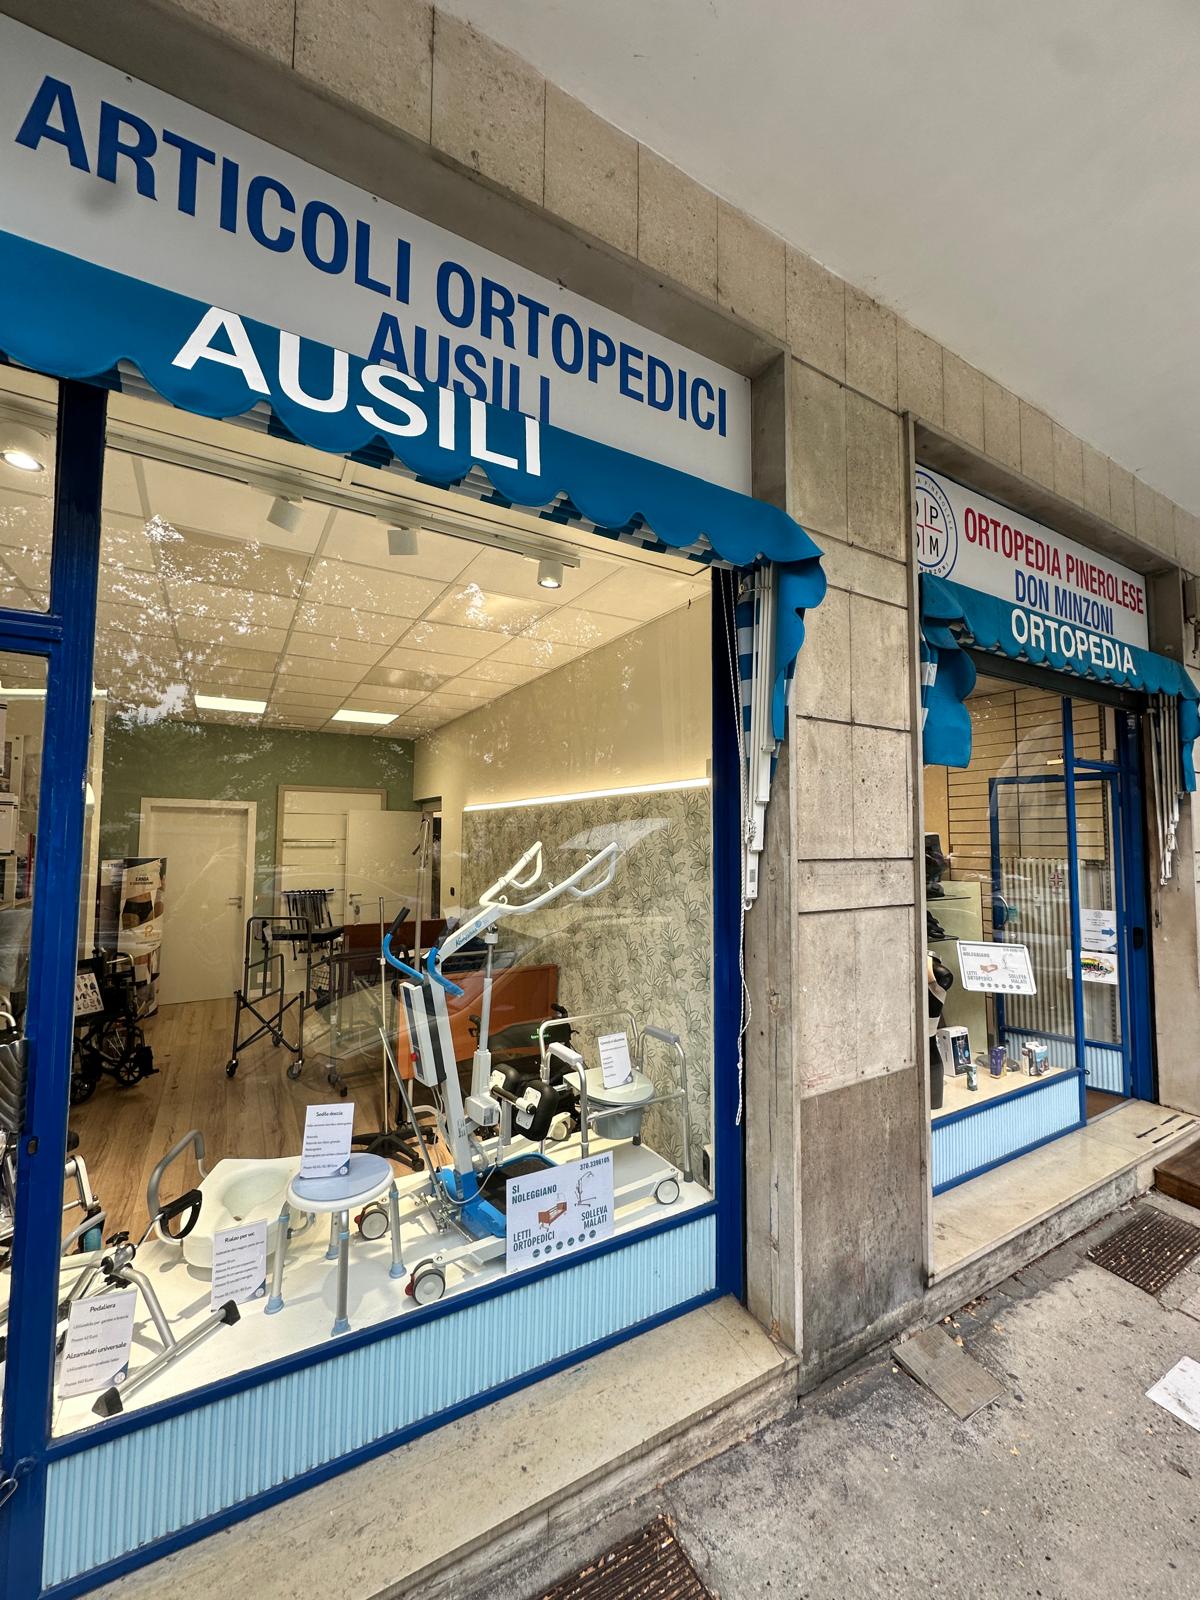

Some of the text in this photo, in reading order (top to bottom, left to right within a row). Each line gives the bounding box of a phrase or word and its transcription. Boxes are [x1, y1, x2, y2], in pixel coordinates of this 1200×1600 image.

[15, 75, 727, 438] ARTICOLI ORTOPEDICI
[368, 312, 550, 424] AUSILI
[171, 306, 541, 476] AUSILI
[964, 507, 1144, 615] ORTOPEDIA PINEROLESE
[1014, 569, 1114, 635] DON MINZONI
[1011, 608, 1137, 676] ORTOPEDIA
[511, 1184, 520, 1194] SI
[511, 1184, 557, 1204] NOLEGGIANO
[581, 1204, 608, 1221] SOLLEVA
[583, 1214, 607, 1229] MALATI
[513, 1229, 531, 1242] LETTI
[513, 1231, 555, 1252] ORTOPEDICI
[89, 1302, 116, 1313] Pedaliera
[66, 1341, 127, 1360] Alzamalati universale
